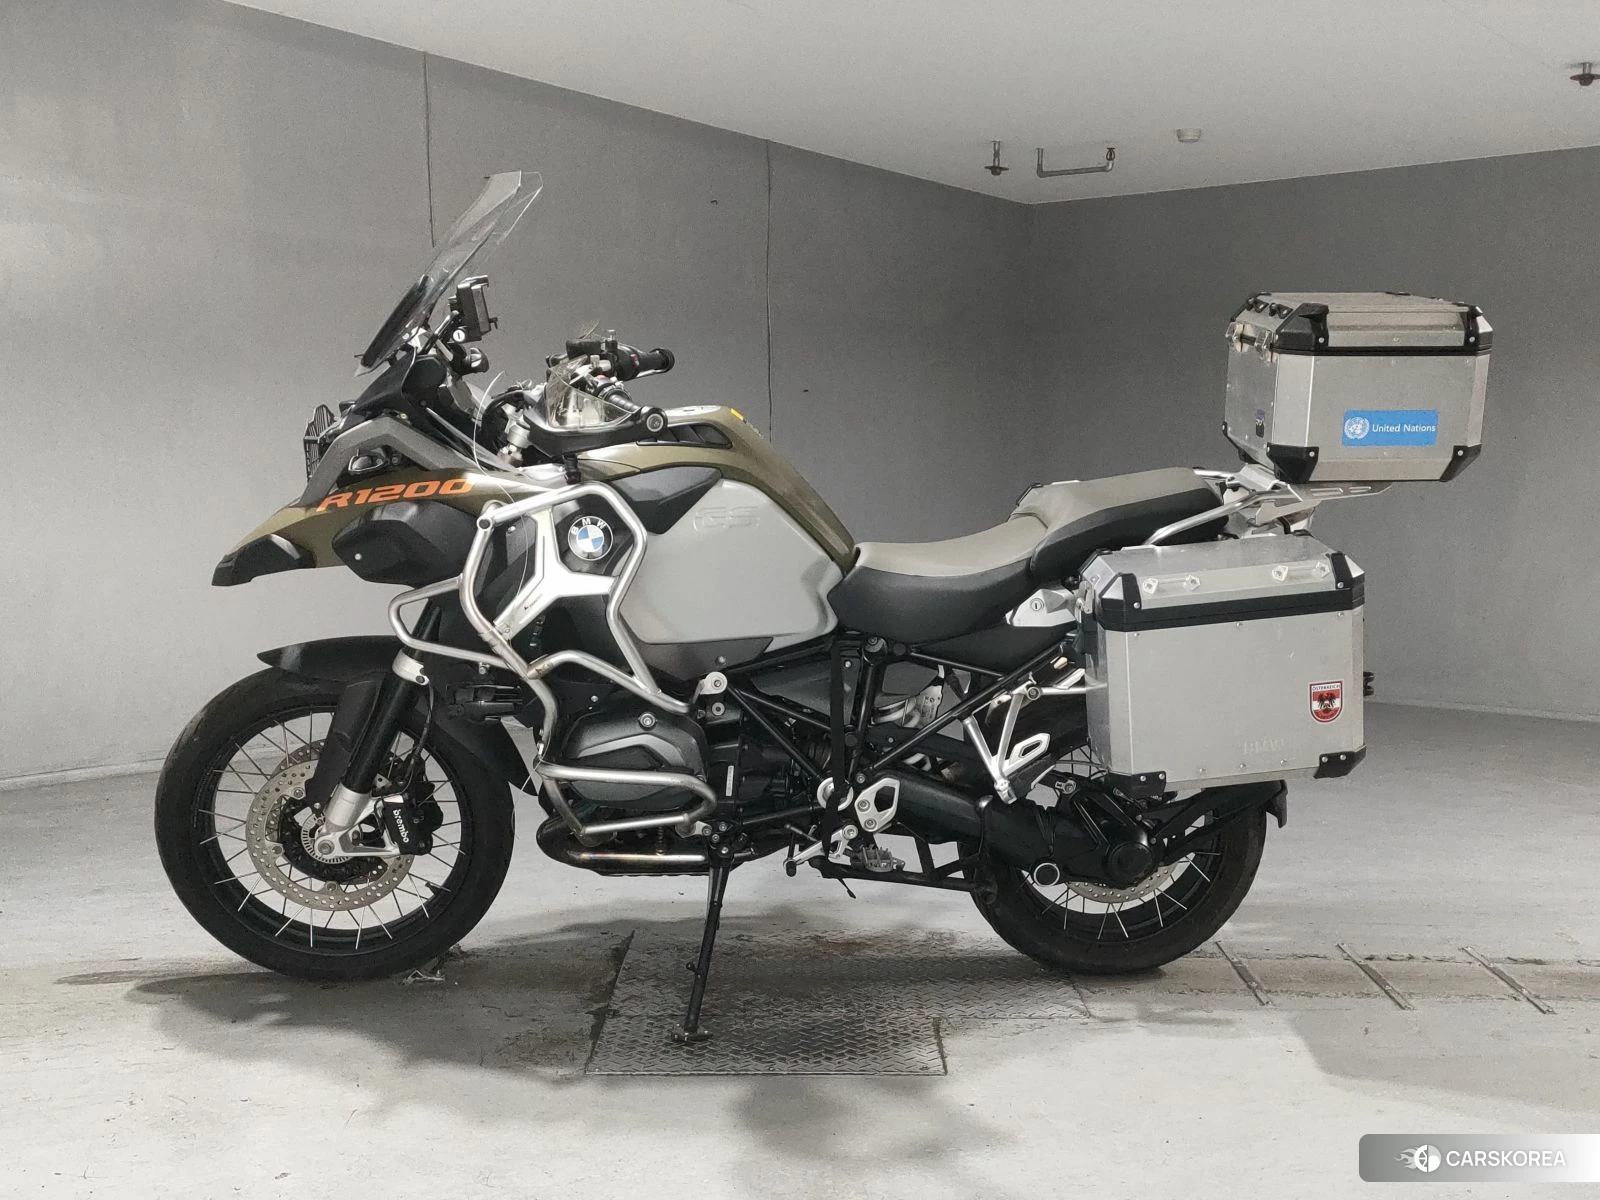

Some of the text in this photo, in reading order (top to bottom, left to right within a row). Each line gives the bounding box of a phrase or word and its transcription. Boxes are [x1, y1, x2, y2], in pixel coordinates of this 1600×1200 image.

[1372, 424, 1436, 433] United Nations
[315, 478, 475, 512] R1200
[570, 517, 607, 535] BMW
[393, 809, 410, 843] brembo
